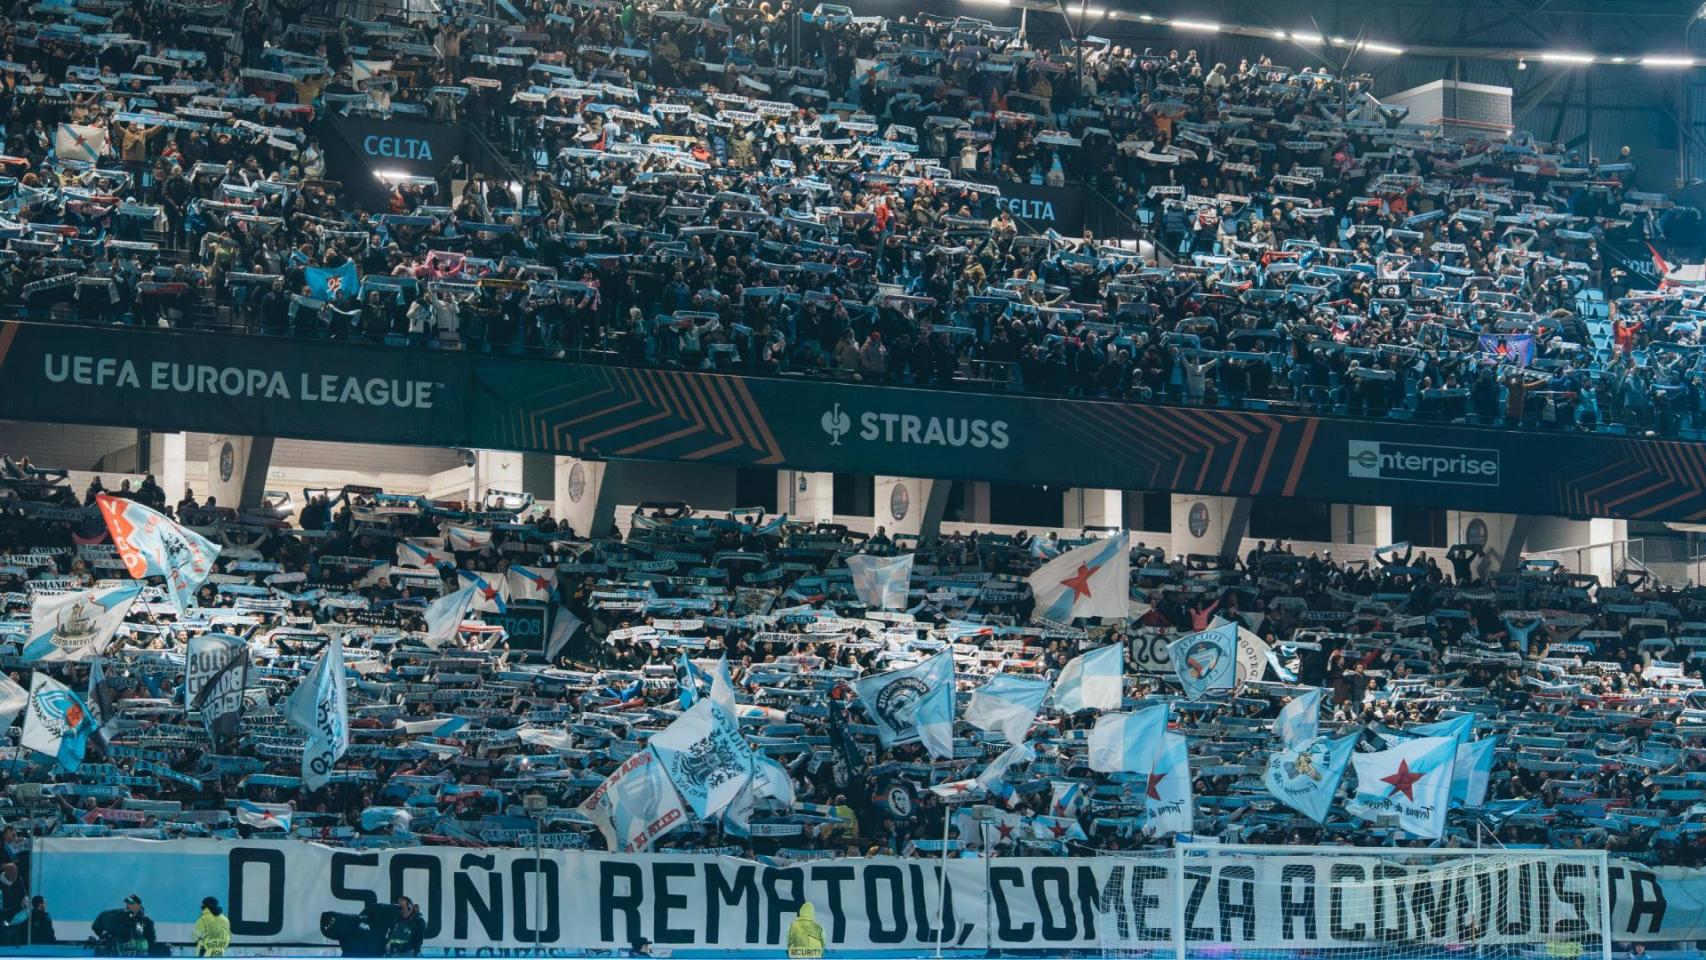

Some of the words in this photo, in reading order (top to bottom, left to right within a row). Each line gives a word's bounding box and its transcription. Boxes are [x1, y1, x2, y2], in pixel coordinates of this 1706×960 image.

[364, 135, 433, 160] CELTA
[45, 354, 140, 387] UEFA
[152, 361, 290, 399] EUROPA
[301, 373, 433, 409] LEAGUE
[860, 411, 1009, 449] STRAUSS
[1357, 448, 1498, 478] enterprise
[101, 500, 139, 568] VIGO
[229, 847, 285, 937] O
[331, 851, 560, 943] SOÑO
[599, 861, 975, 945] REMATOU,
[990, 865, 1256, 943] COMEZA
[1281, 863, 1317, 940] A
[1329, 861, 1667, 940] CONQUISTA
